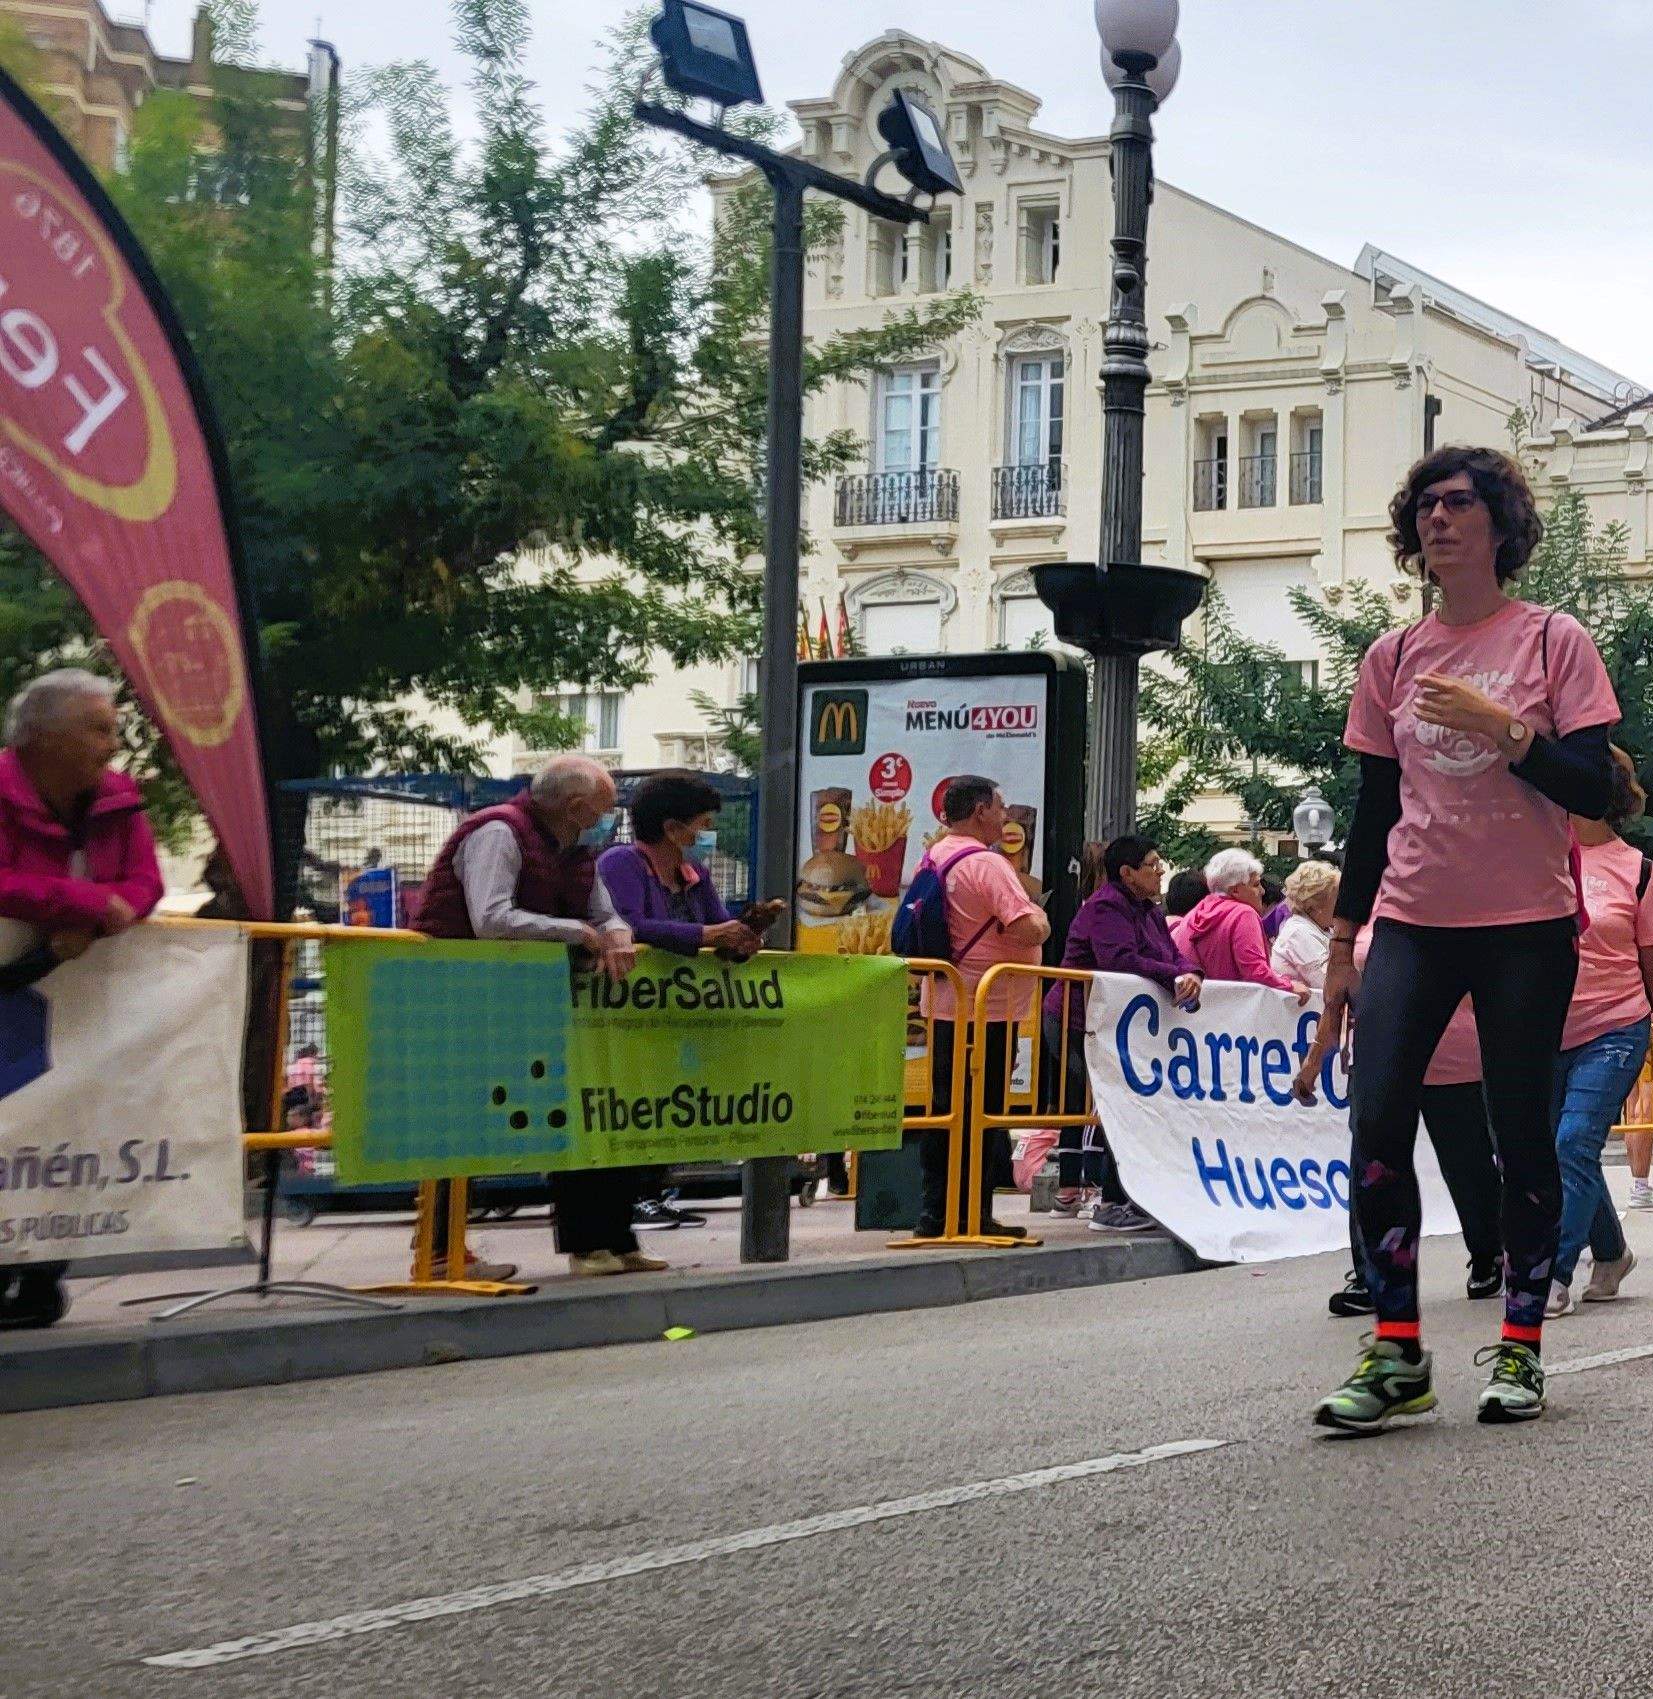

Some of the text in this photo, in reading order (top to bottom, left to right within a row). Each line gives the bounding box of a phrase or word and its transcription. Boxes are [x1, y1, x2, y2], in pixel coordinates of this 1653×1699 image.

[900, 660, 946, 672] URBAN
[905, 703, 969, 731] MENÚ
[571, 966, 784, 1010] FiberSalud
[580, 1081, 794, 1133] FiberStudio
[116, 1137, 191, 1184] S.L.
